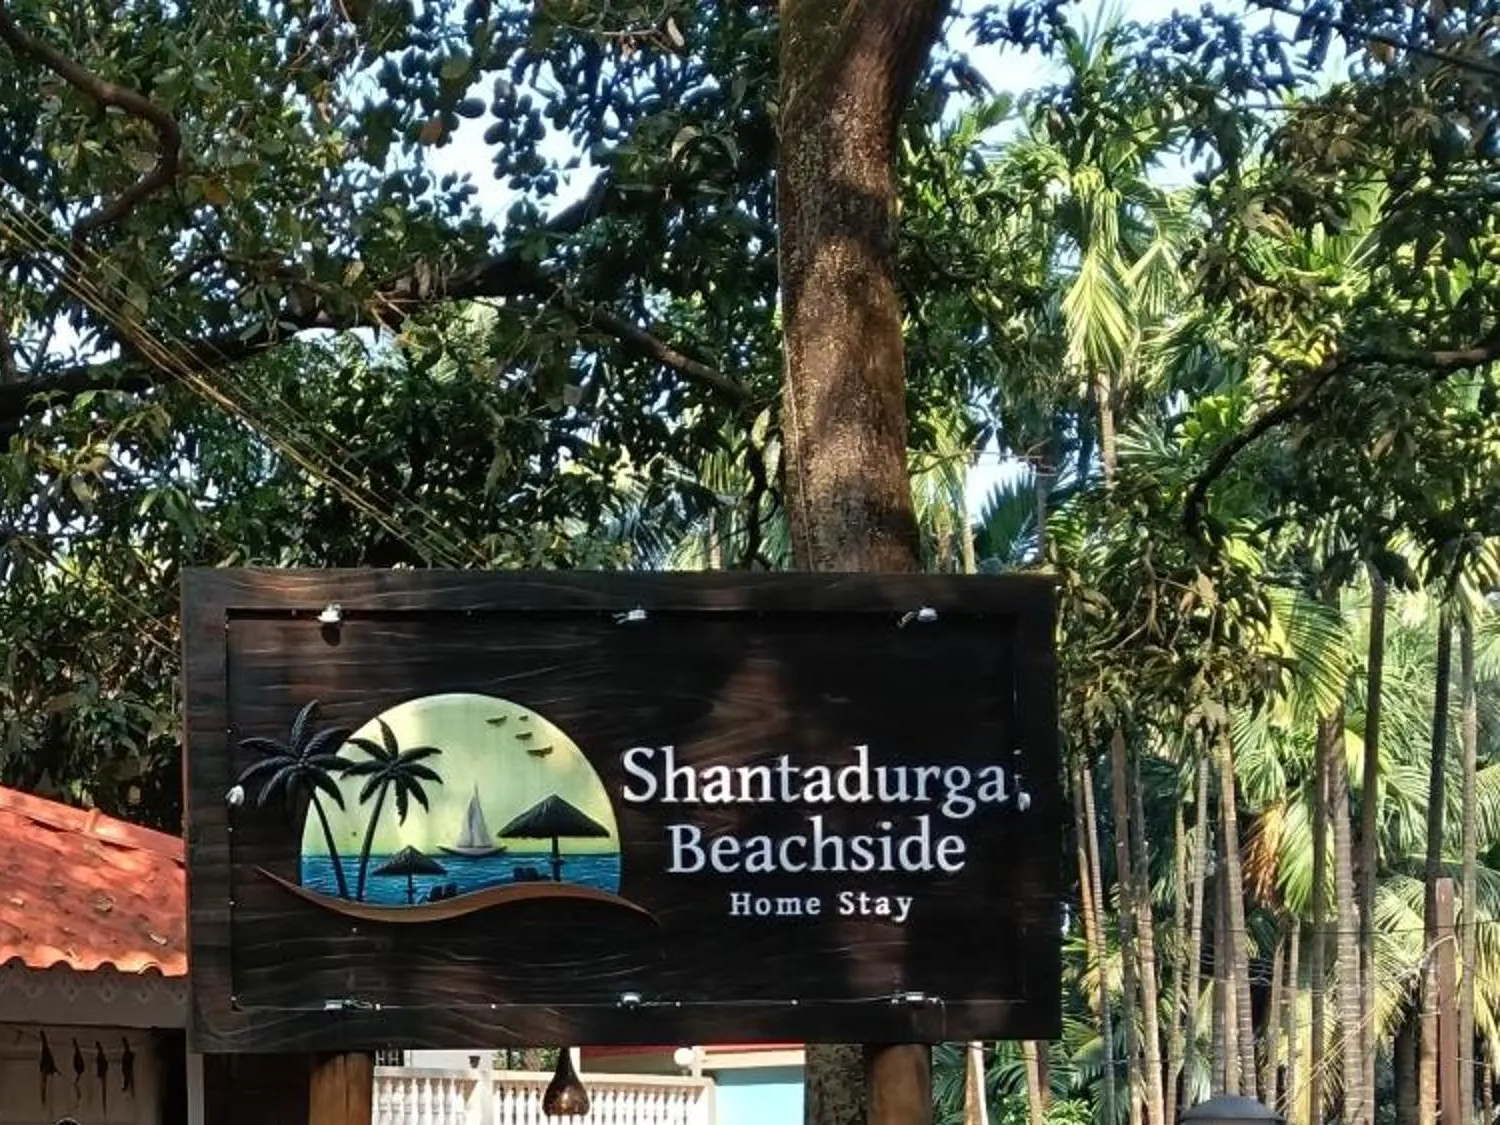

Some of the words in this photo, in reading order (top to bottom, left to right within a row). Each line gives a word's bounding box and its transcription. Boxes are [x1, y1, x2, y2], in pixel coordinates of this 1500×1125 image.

[621, 744, 1010, 819] Shantadurga
[666, 815, 967, 874] Beachside
[729, 891, 821, 916] Home
[839, 890, 913, 922] Stay
